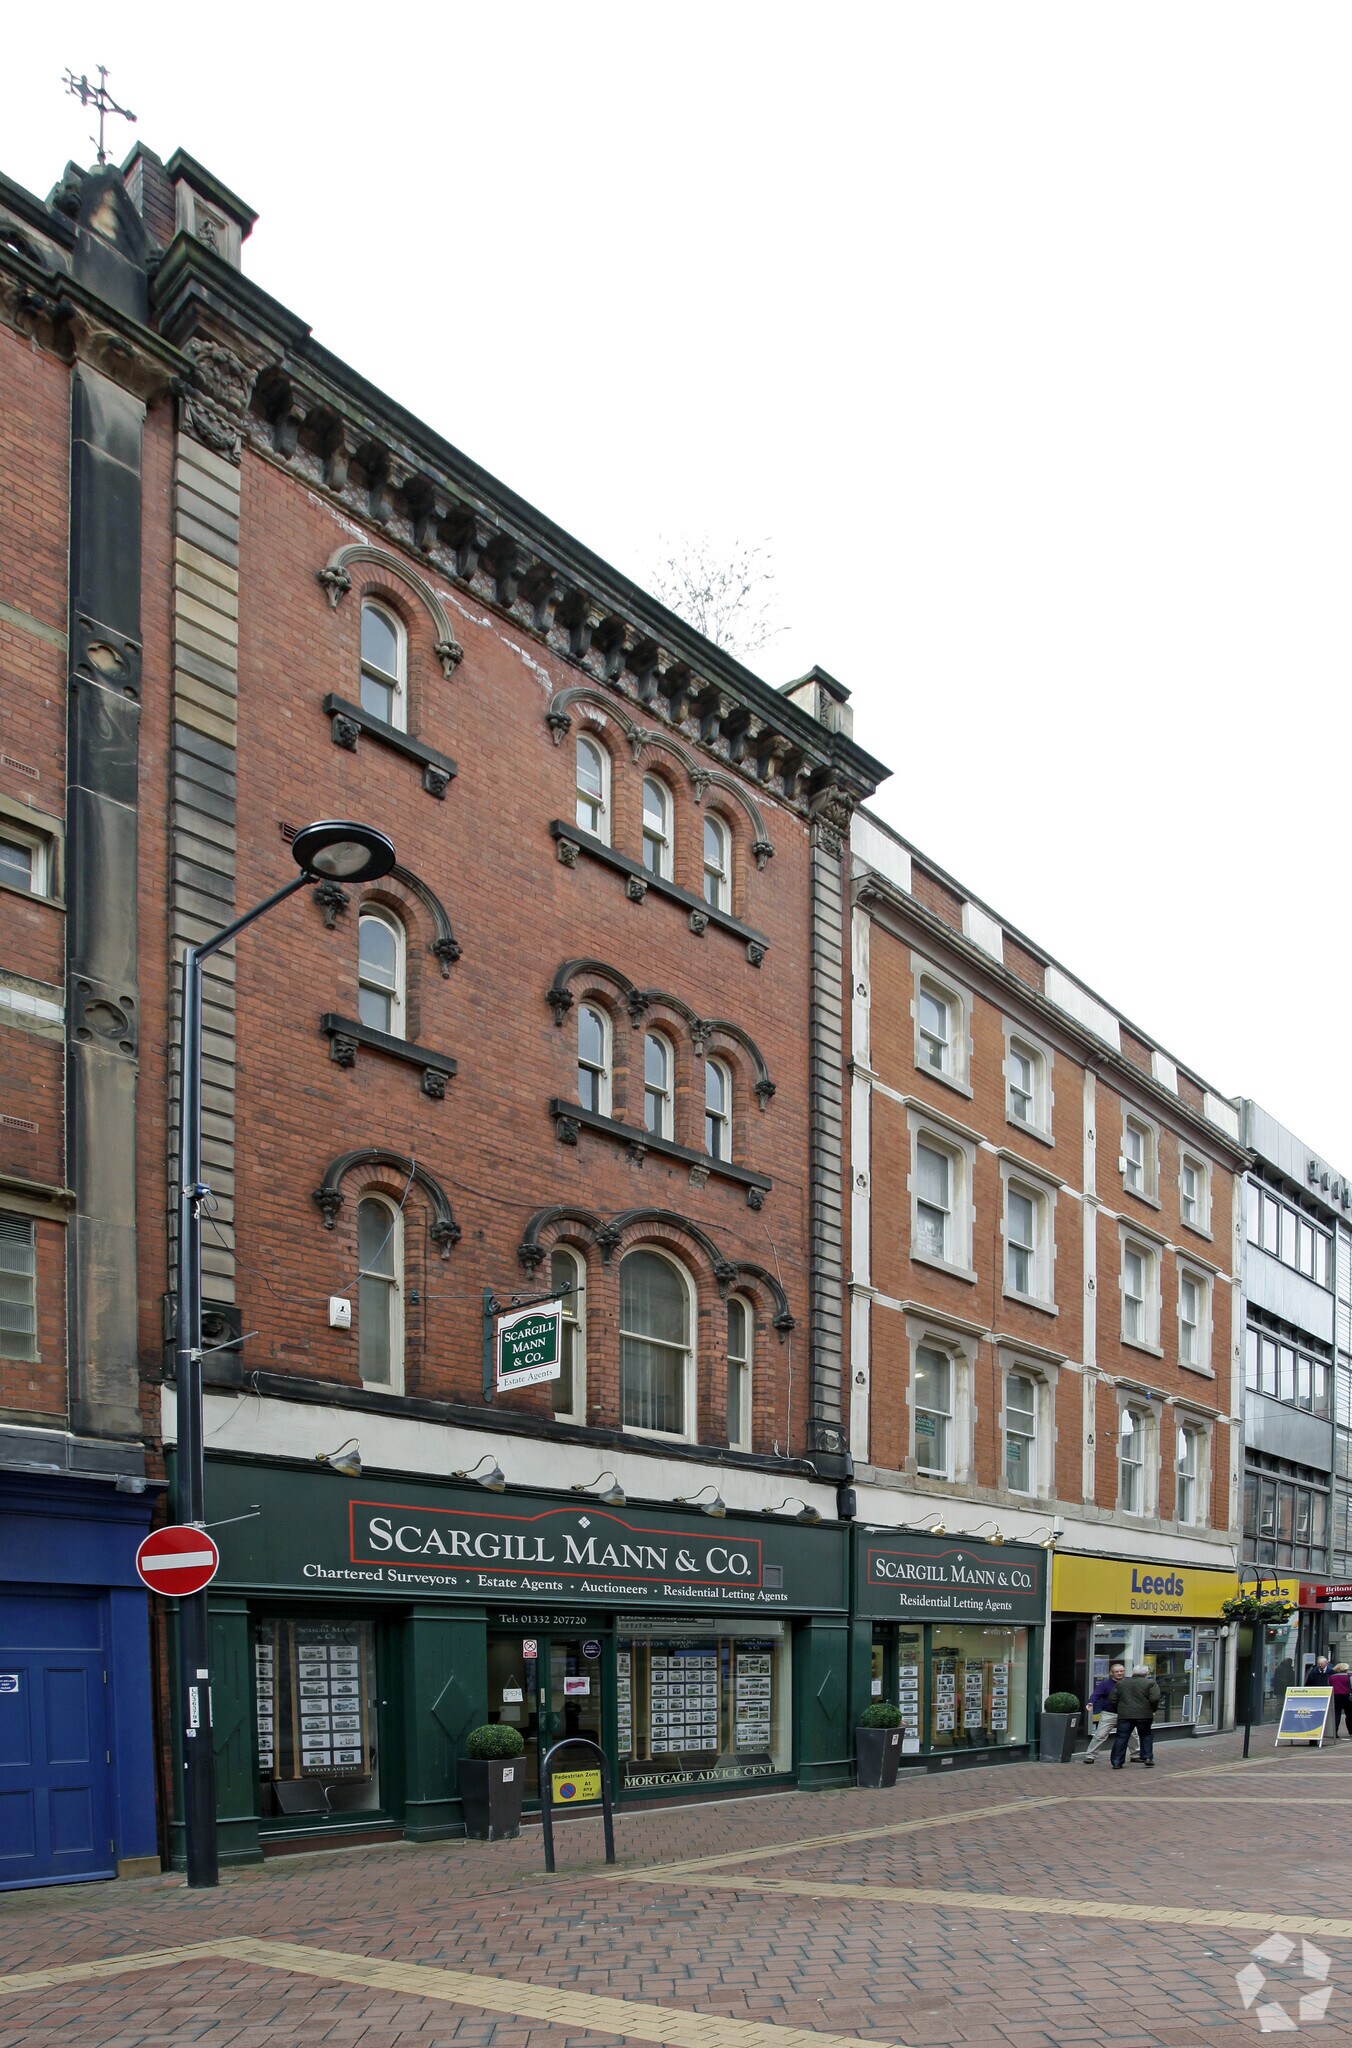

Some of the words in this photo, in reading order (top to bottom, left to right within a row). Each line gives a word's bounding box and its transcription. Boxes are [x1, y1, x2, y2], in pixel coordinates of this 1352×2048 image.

[504, 1322, 555, 1342] SCARGILL
[512, 1338, 546, 1354] MANN
[513, 1357, 522, 1367] &
[504, 1377, 525, 1387] Estate
[528, 1370, 553, 1381] Agents
[368, 1517, 555, 1563] SCARGILL
[562, 1534, 668, 1570] MANN
[675, 1549, 700, 1572] &
[875, 1557, 948, 1582] SCARGILL
[950, 1564, 995, 1585] MANN
[997, 1571, 1009, 1586] &
[302, 1563, 383, 1581] Chartered
[387, 1569, 457, 1586] Surveyors
[477, 1574, 517, 1588] Estate
[520, 1577, 563, 1591] Agents
[580, 1580, 648, 1595] Auctioneers
[663, 1584, 719, 1598] Residential
[721, 1585, 755, 1601] Letting
[757, 1590, 788, 1602] Agents
[1131, 1568, 1184, 1597] Leeds
[899, 1593, 951, 1608] Residential
[953, 1596, 983, 1611] Letting
[985, 1598, 1012, 1612] Agents
[1130, 1598, 1158, 1613] Building
[1159, 1601, 1184, 1614] Society
[499, 1614, 519, 1623] Tel:
[521, 1615, 550, 1624] 01332
[553, 1615, 587, 1625] 207720
[624, 1772, 694, 1788] MORTGAGE
[696, 1767, 741, 1782] ADVICE
